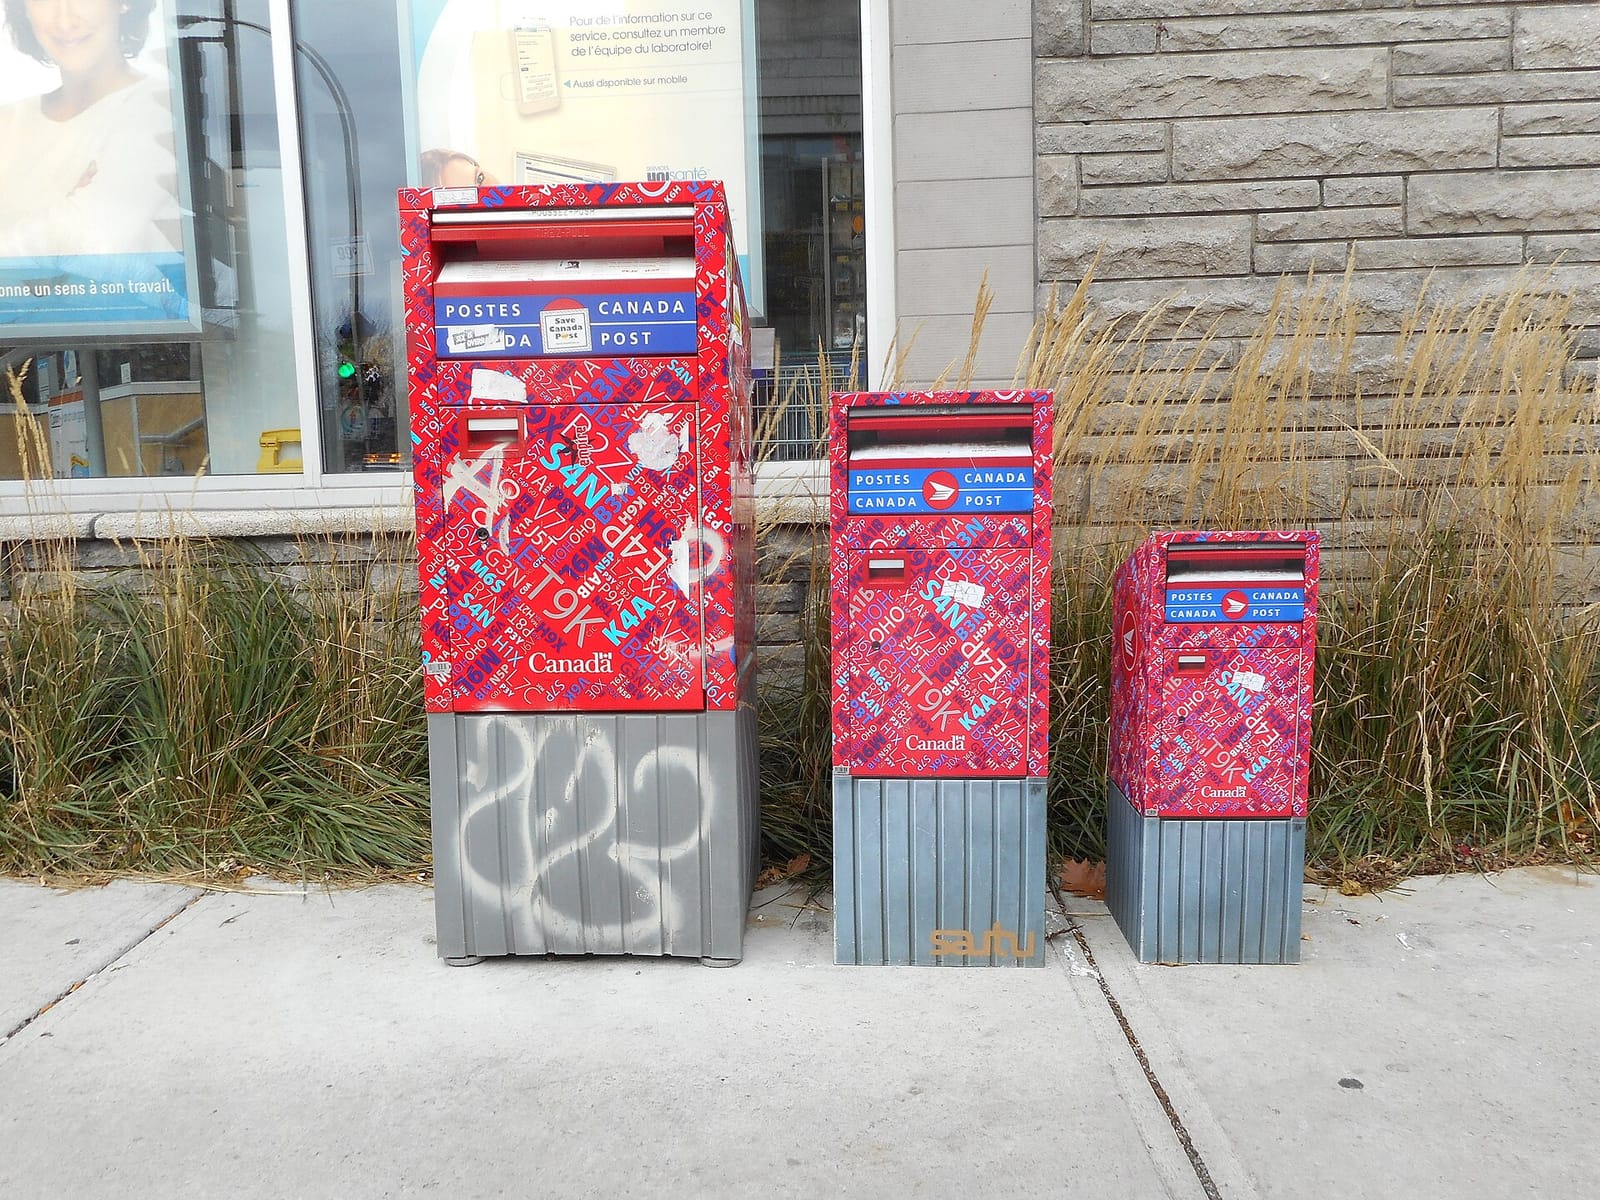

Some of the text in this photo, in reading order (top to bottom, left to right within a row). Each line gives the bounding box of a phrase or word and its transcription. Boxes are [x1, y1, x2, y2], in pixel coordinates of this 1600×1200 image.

[570, 12, 712, 27] Pour de l'information sur ce
[570, 25, 726, 42] service, consultez un membre
[571, 40, 712, 57] de l'équipe du laboratoire!
[573, 74, 688, 88] Aussi disponible sur mobile
[664, 185, 681, 203] K6H
[34, 284, 50, 296] un
[54, 283, 86, 295] sens
[89, 280, 98, 294] à
[101, 282, 125, 294] son
[128, 278, 175, 294] travail.
[446, 300, 684, 318] POSTES CANADA
[601, 332, 652, 346] POST
[444, 362, 462, 383] S7P
[520, 363, 538, 381] K6H
[533, 369, 561, 396] B2Z
[562, 360, 600, 396] X1A
[650, 362, 665, 378] M3C
[667, 360, 693, 385] S4N
[576, 359, 630, 416] B3N
[527, 438, 546, 459] S7P
[513, 458, 547, 491] X1A
[540, 443, 610, 509] S4N
[634, 476, 657, 498] P8T
[856, 472, 1026, 485] POSTES CANADA
[679, 483, 696, 502] P3Y
[856, 496, 1002, 508] CANADA POST
[534, 498, 574, 540] V7J
[618, 496, 647, 525] K6H
[513, 517, 533, 535] Y1A
[524, 526, 557, 552] J5T
[936, 518, 964, 545] X1A
[1010, 518, 1028, 536] S4N
[595, 551, 614, 572] N5P
[602, 524, 667, 580] E4P
[470, 560, 506, 593] M6S
[486, 549, 526, 588] G3N
[602, 572, 617, 584] P3Y
[610, 559, 644, 592] L7C
[470, 581, 503, 614] R7N
[577, 572, 601, 598] A1B
[598, 583, 624, 611] P9A
[643, 580, 676, 616] X1A
[1172, 591, 1299, 601] POSTES CANADA
[458, 593, 495, 628] S4N
[528, 563, 605, 648] T9K
[919, 580, 968, 629] S4N
[1170, 608, 1281, 618] CANADA POST
[508, 613, 534, 637] P8T
[602, 596, 656, 646] K4A
[956, 609, 986, 640] B3N
[973, 620, 993, 641] K6H
[505, 627, 524, 645] P3Y
[492, 635, 524, 667] H1X
[529, 652, 613, 673] Canada
[962, 641, 1007, 682] E4P
[490, 664, 509, 685] N5P
[505, 669, 541, 704] L7C
[867, 666, 891, 692] M6S
[878, 659, 906, 688] G3N
[942, 676, 960, 696] A1B
[546, 680, 565, 702] S7P
[643, 683, 662, 701] H1T
[907, 669, 961, 732] T9K
[988, 682, 1012, 708] X1A
[1216, 671, 1251, 707] S4N
[858, 691, 883, 717] S4N
[959, 695, 997, 730] K4A
[881, 722, 902, 746] H1X
[906, 735, 966, 751] Canada
[1246, 716, 1280, 747] E4P
[1204, 737, 1244, 784] T9K
[1242, 756, 1271, 783] K4A
[1201, 786, 1246, 798] Canada
